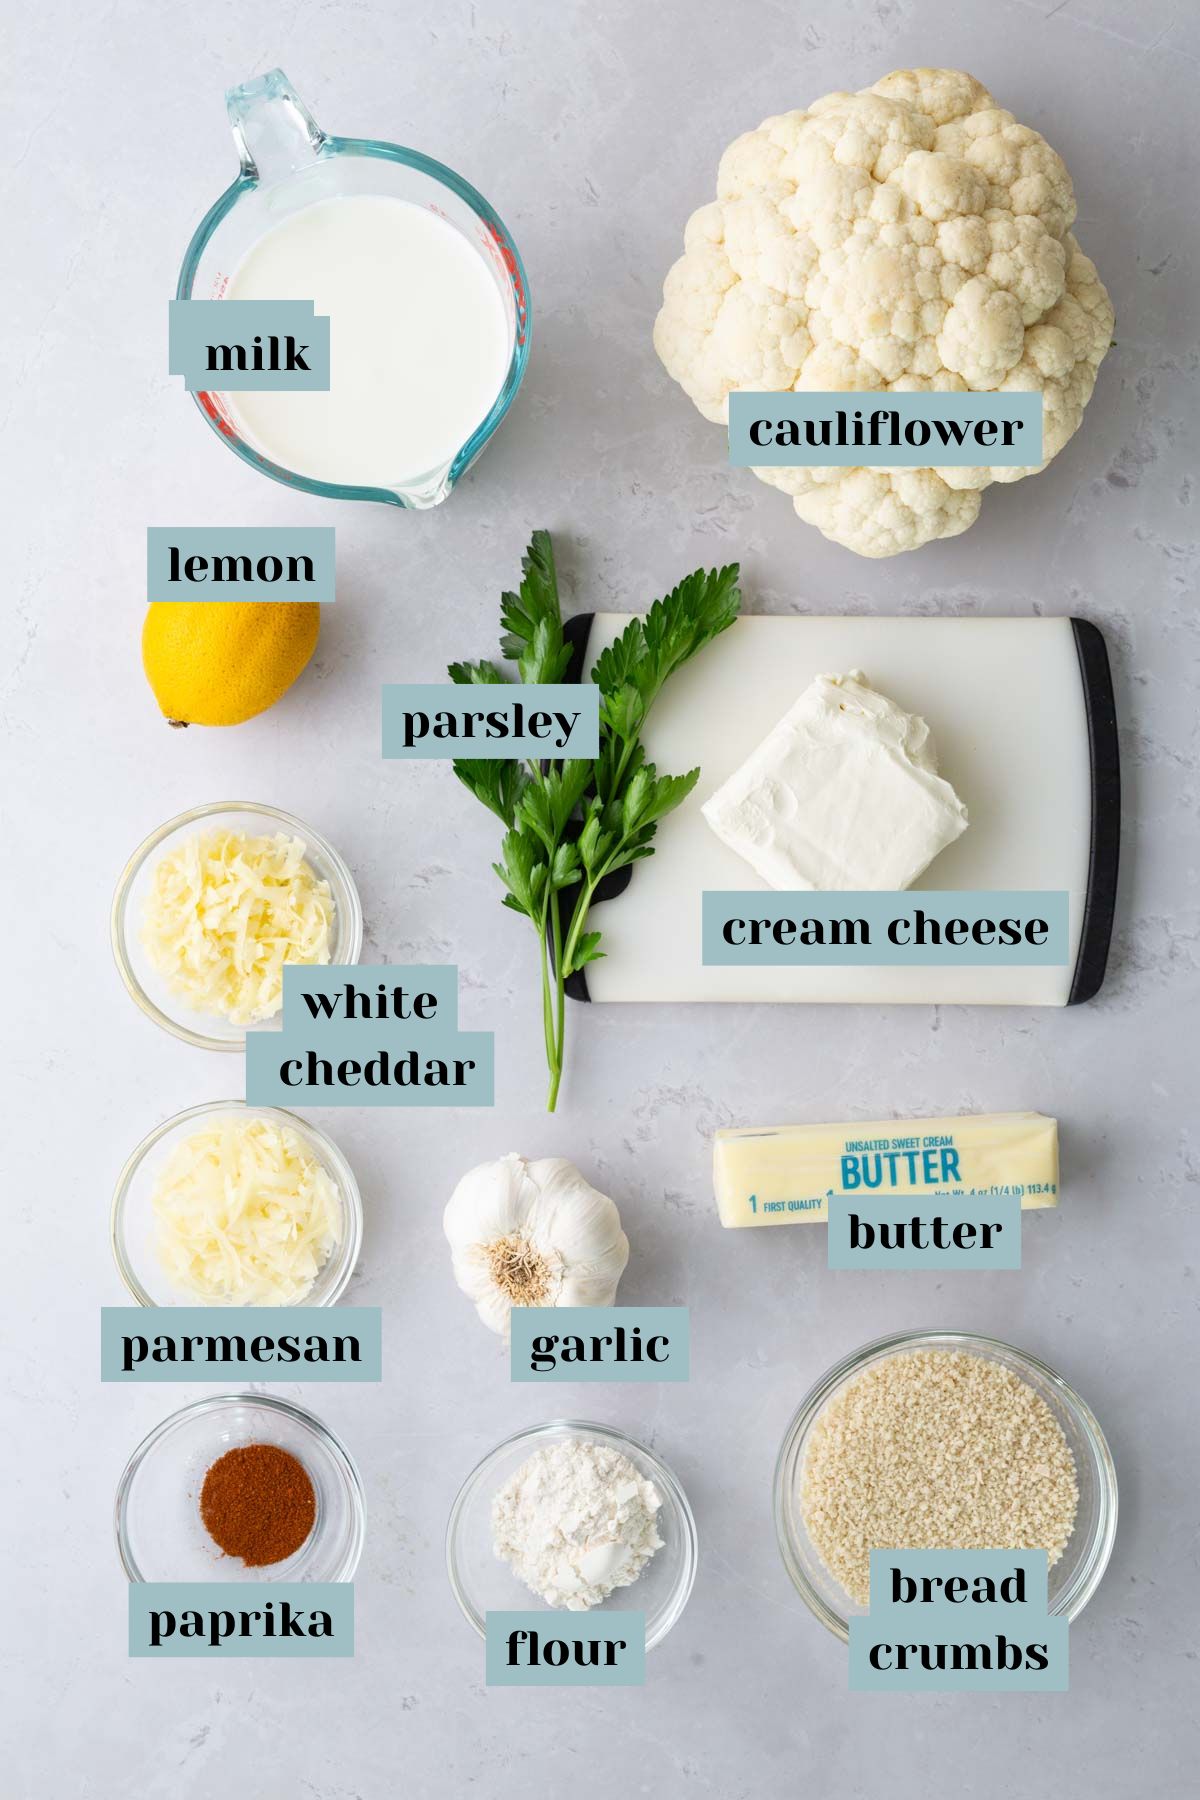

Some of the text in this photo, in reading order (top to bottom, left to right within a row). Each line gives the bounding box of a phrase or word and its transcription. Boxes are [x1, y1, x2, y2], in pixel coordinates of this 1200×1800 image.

[845, 1135, 953, 1153] UNSALTED SWEET CREAM
[840, 1147, 962, 1190] BUTTER
[1027, 1182, 1049, 1196] 113.4
[748, 1194, 822, 1214] 1 FIRST QUALITY
